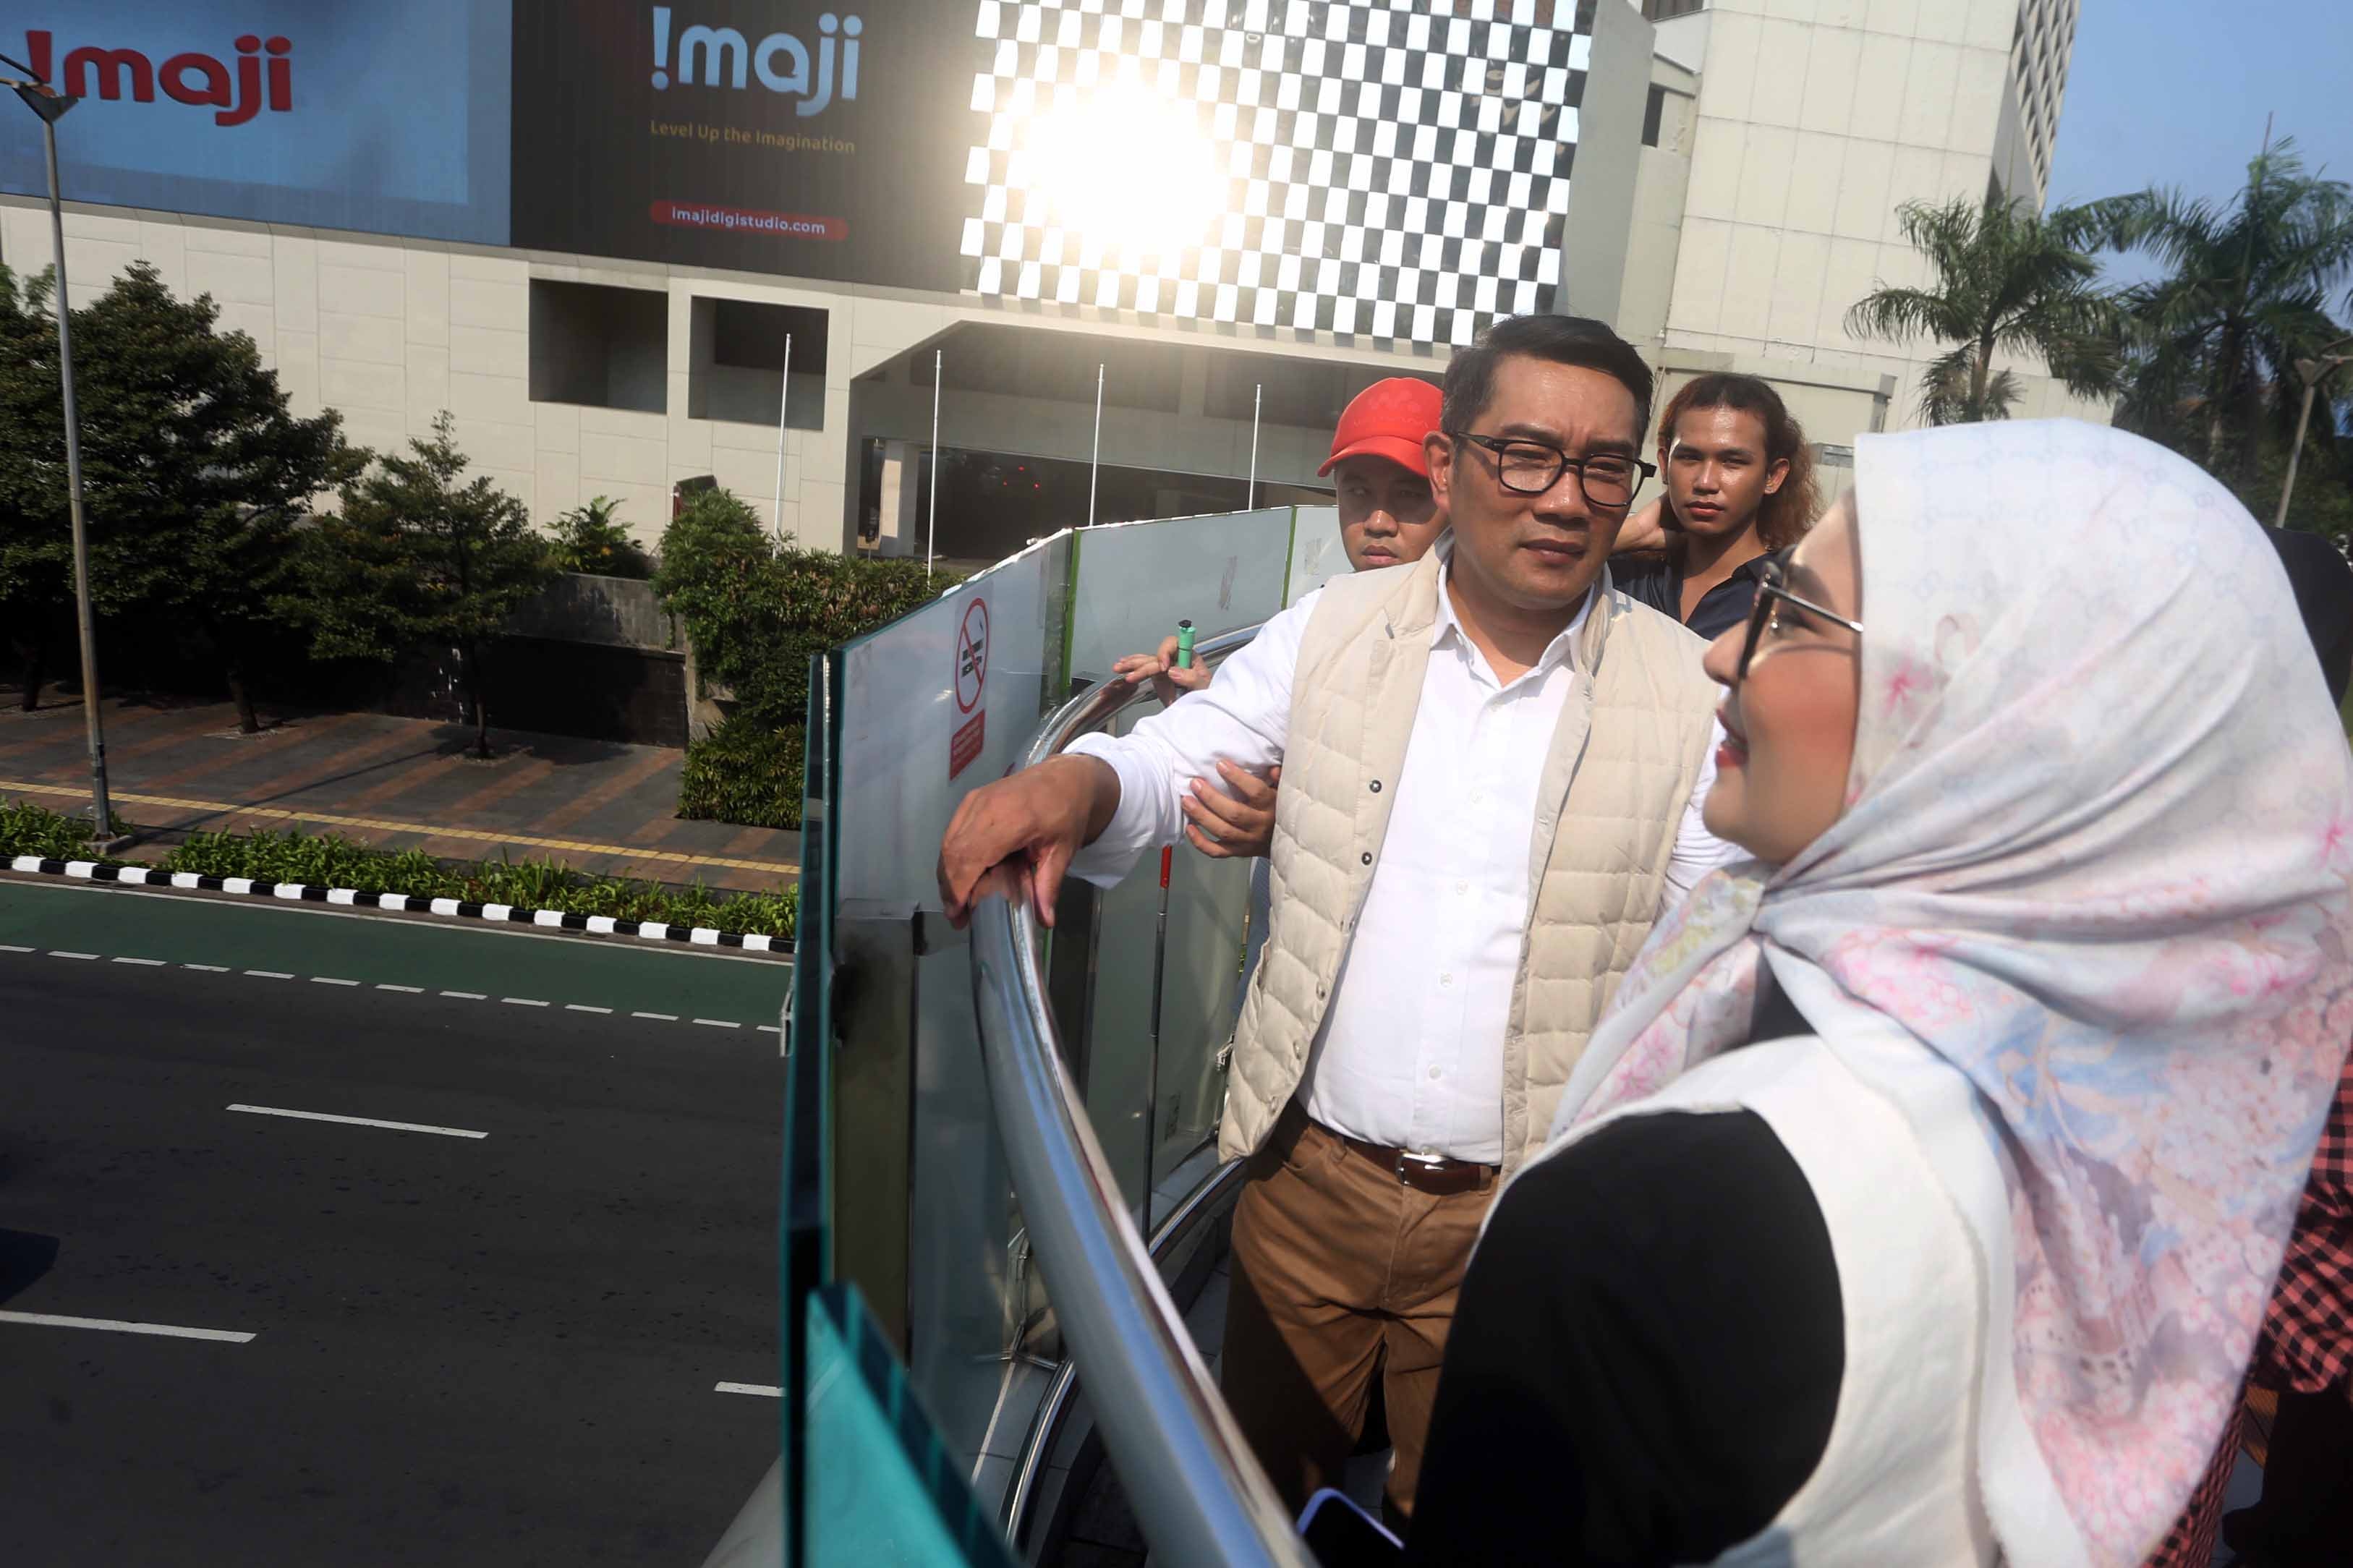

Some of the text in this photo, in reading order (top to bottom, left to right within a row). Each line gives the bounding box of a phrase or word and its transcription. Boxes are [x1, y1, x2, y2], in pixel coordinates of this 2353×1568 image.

[650, 119, 855, 155] Level Up the Imagination
